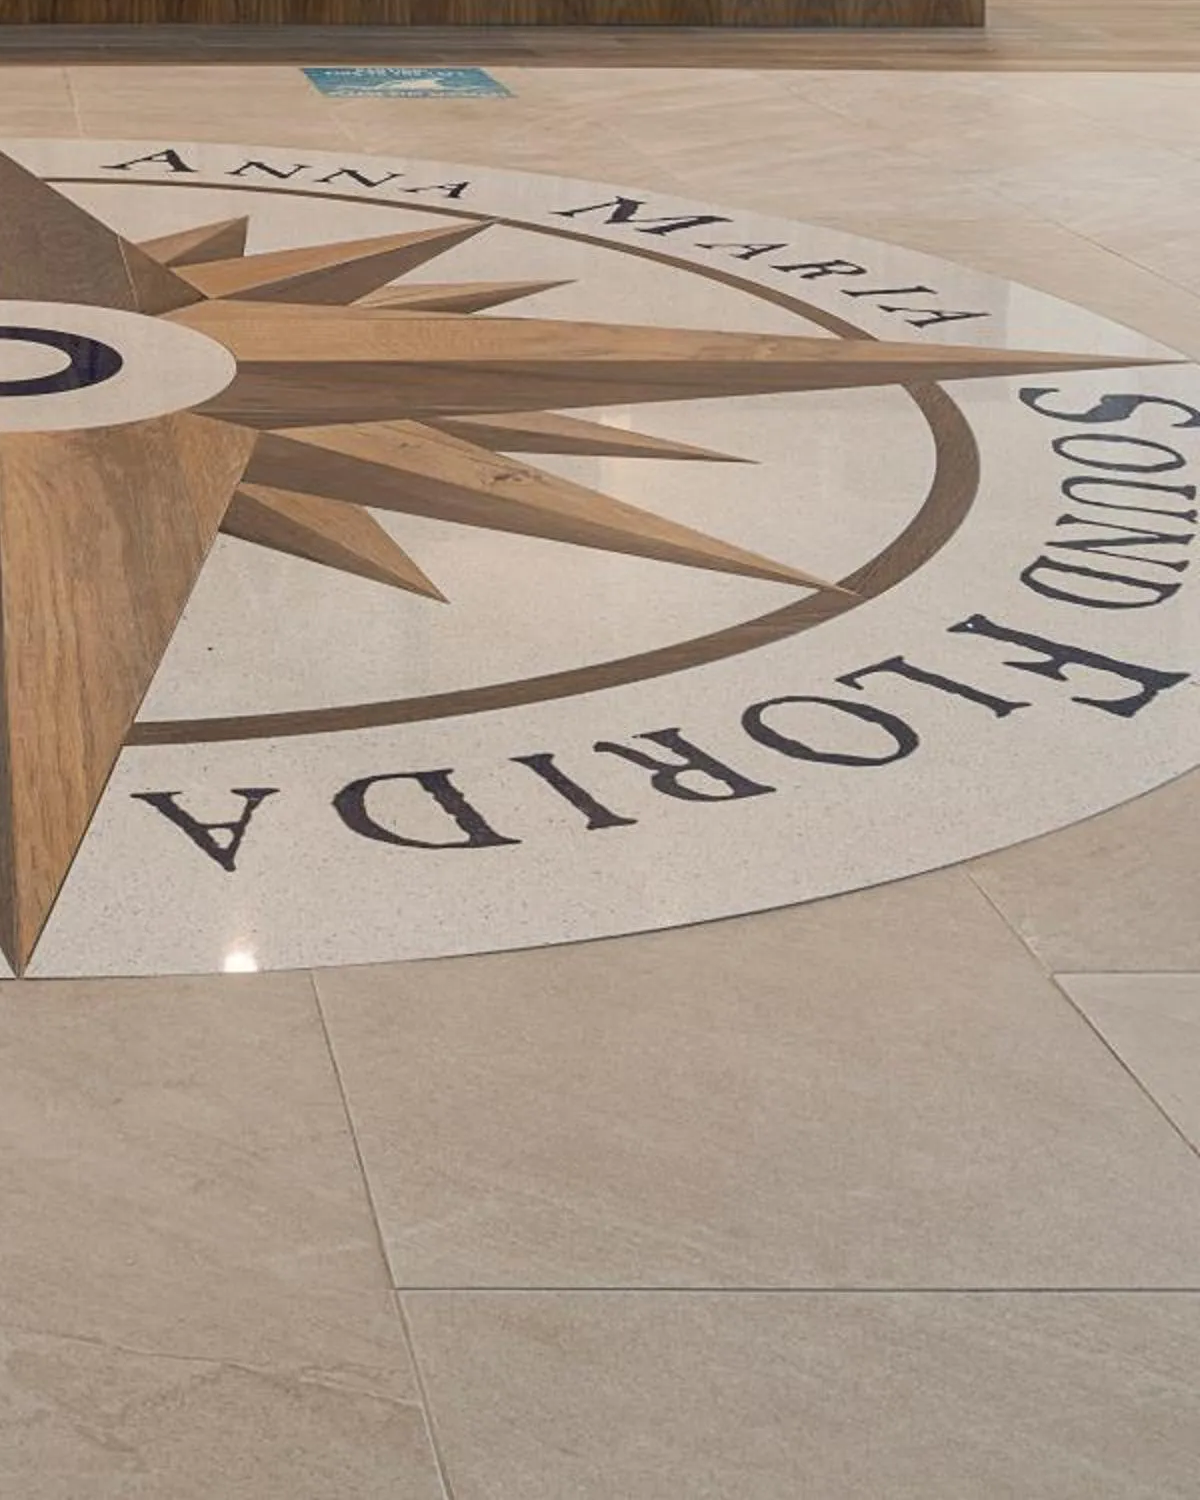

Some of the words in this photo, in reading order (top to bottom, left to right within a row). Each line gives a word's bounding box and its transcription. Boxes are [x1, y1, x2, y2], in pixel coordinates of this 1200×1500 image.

[102, 149, 469, 199] ANNA
[551, 195, 990, 328] MARIA
[1019, 387, 1200, 610] SOUND
[130, 613, 1191, 872] FLORIDA
